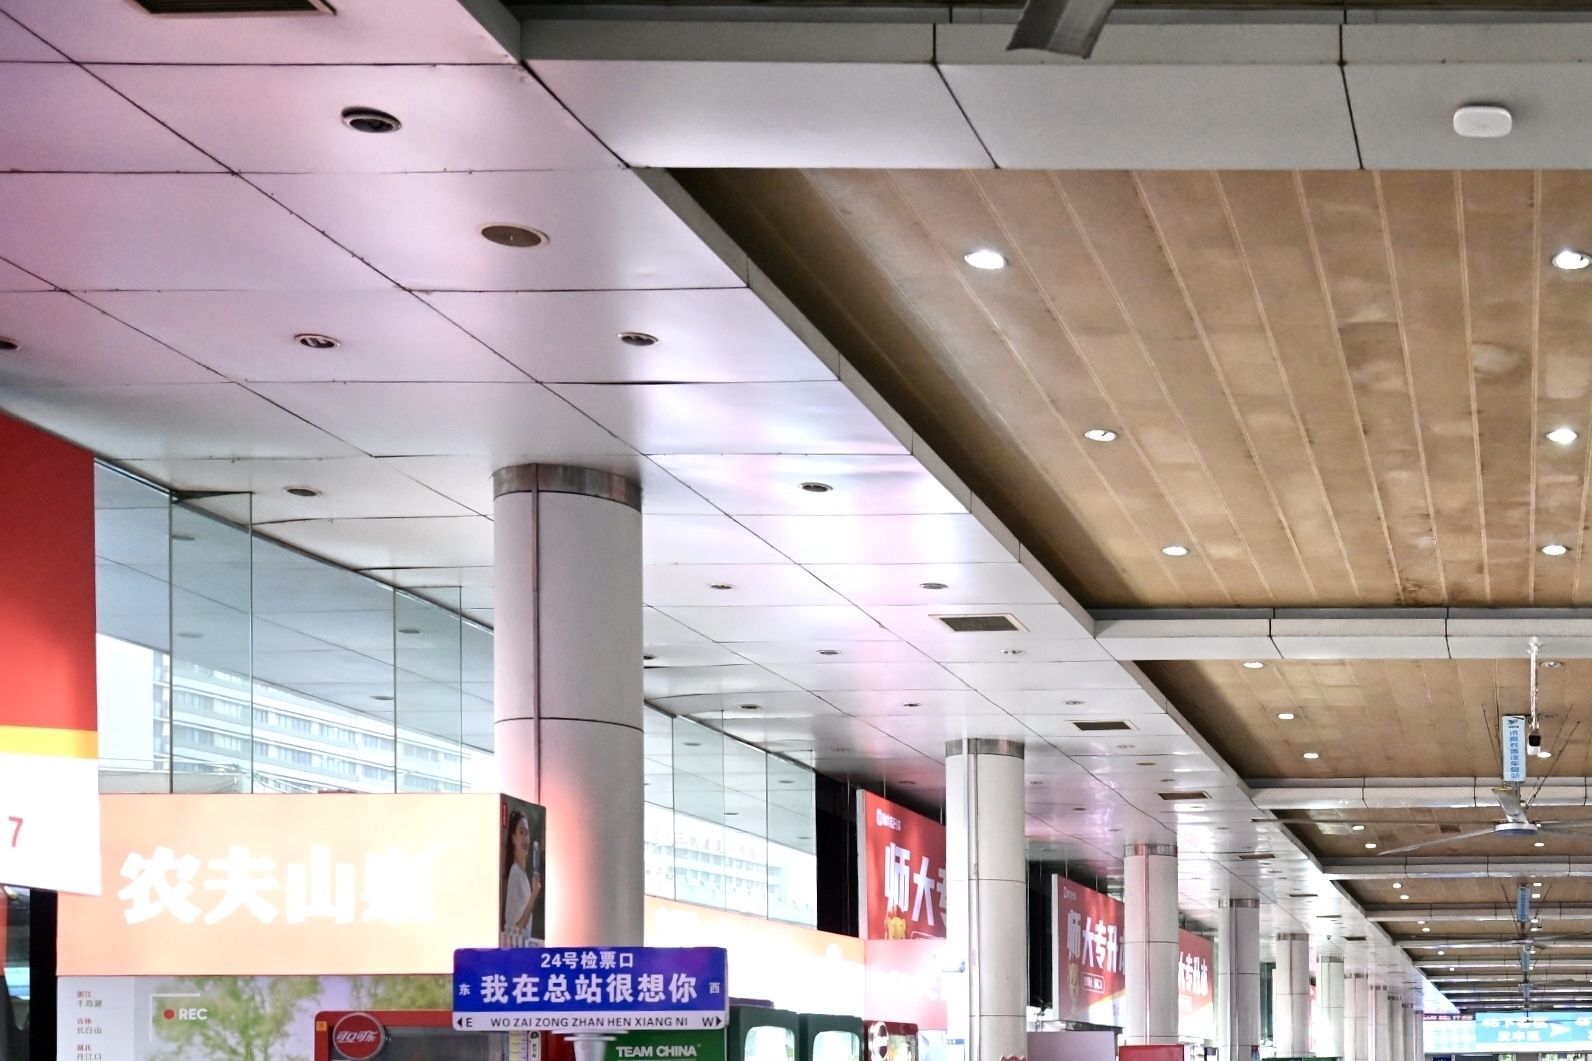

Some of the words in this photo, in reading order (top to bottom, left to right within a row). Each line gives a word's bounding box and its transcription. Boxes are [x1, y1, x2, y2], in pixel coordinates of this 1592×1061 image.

[541, 951, 634, 969] 24号检票口
[459, 983, 471, 996] 东
[480, 973, 698, 1004] 我在总站很想你
[709, 982, 721, 994] 西
[179, 1008, 208, 1020] REC
[465, 1017, 473, 1028] E
[491, 1017, 511, 1027] WO
[514, 1017, 532, 1027] ZAI
[535, 1017, 569, 1027] ZONG
[572, 1017, 607, 1027] ZHAN
[608, 1017, 631, 1027] HEN
[634, 1017, 673, 1027] XIANG
[675, 1017, 688, 1027] NI
[702, 1017, 715, 1028] W
[616, 1046, 653, 1057] TEAM
[656, 1045, 697, 1057] CHINA
